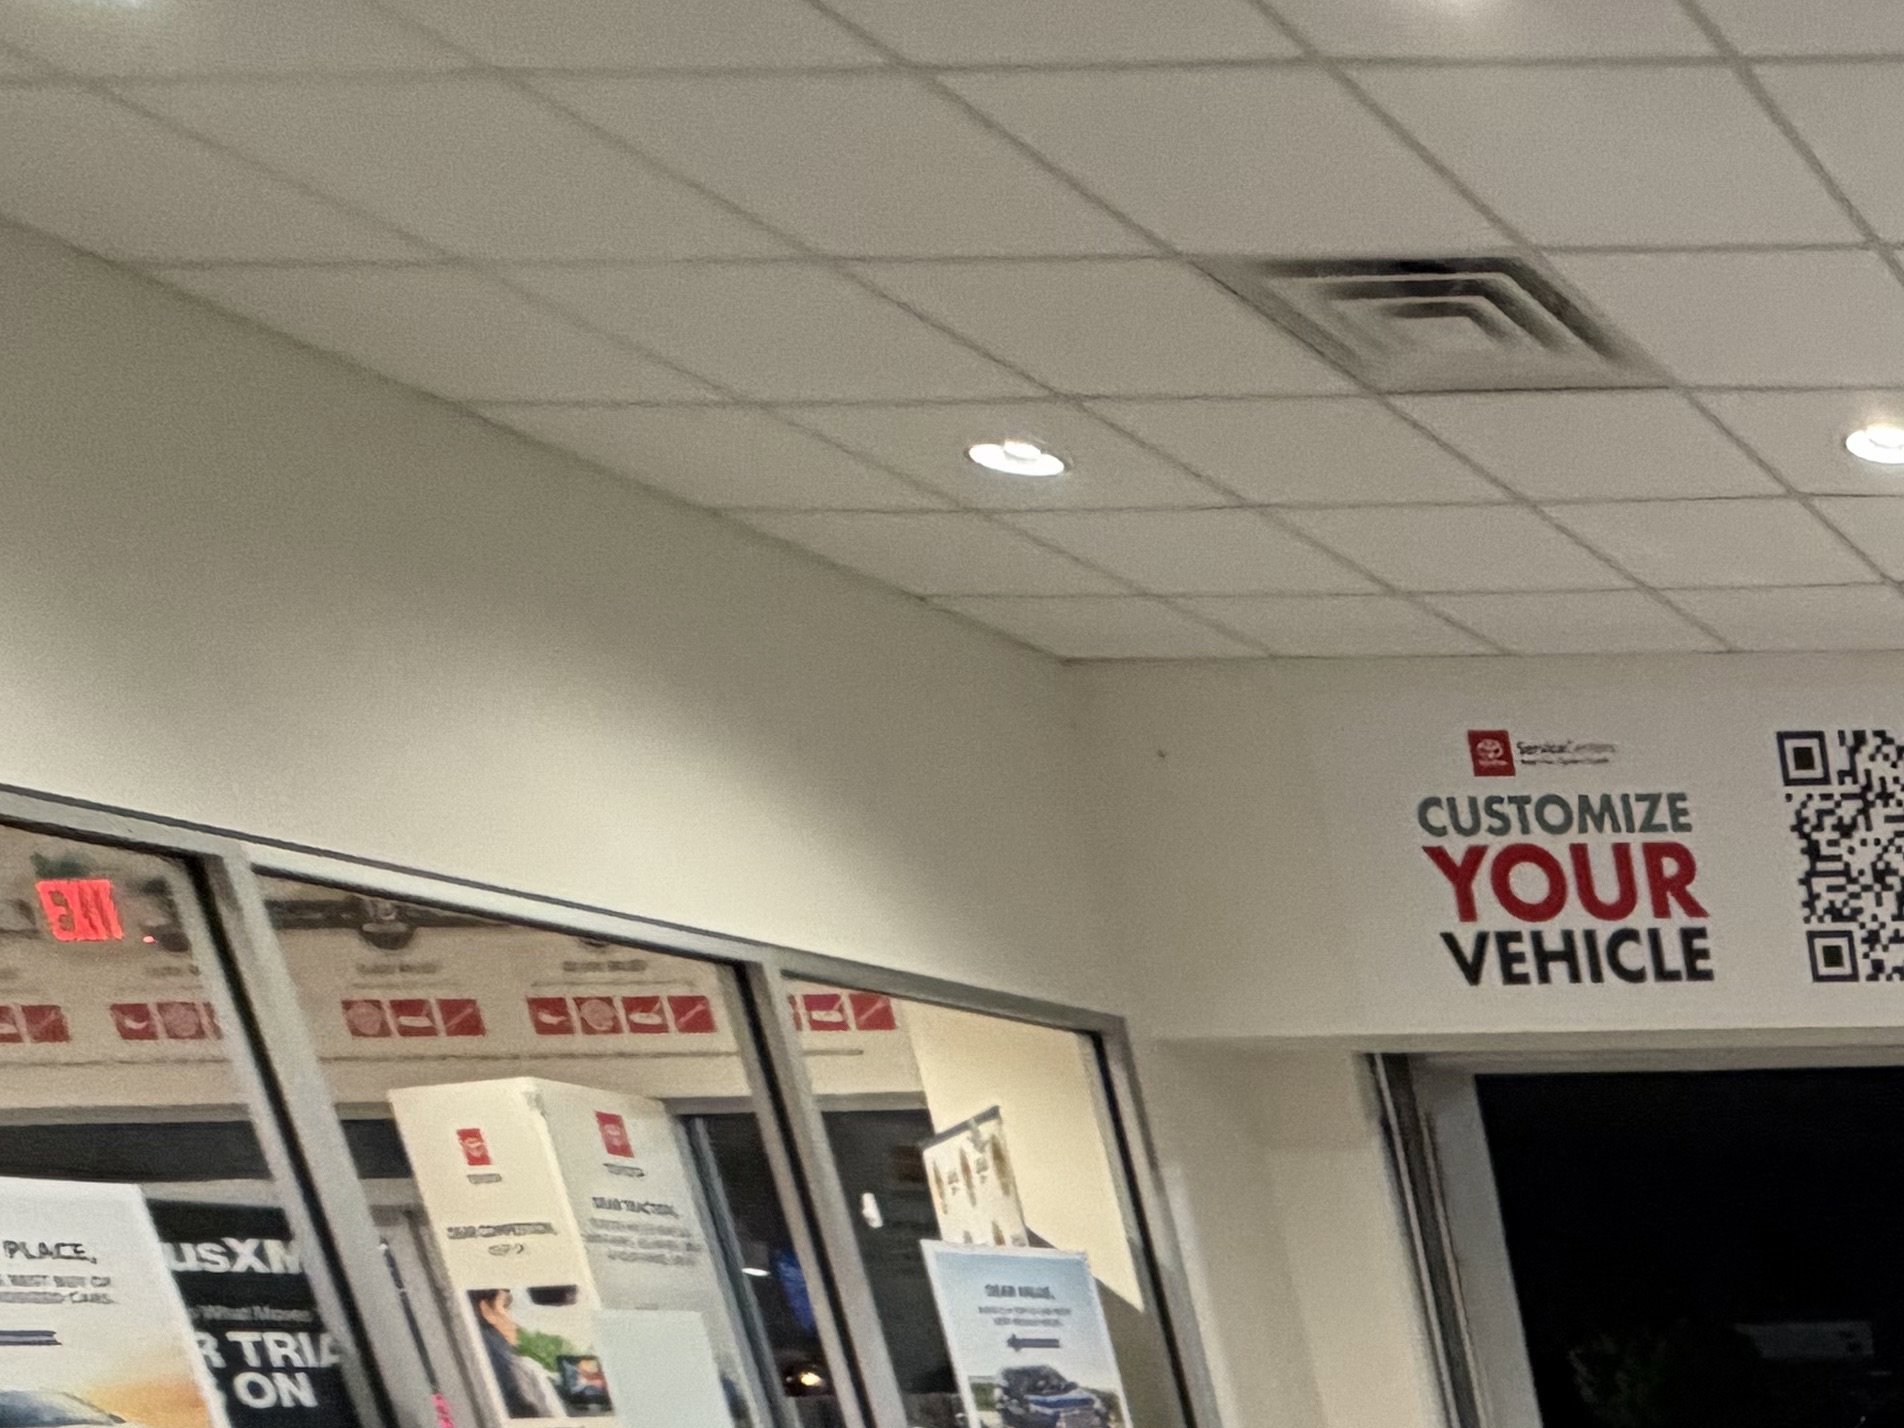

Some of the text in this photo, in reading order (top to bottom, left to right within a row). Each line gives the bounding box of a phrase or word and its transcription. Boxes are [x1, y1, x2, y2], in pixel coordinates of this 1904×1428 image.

[1417, 792, 1694, 838] CUSTOMIZE
[1422, 841, 1711, 922] YOUR
[1439, 926, 1715, 985] VEHICLE
[232, 1371, 320, 1410] ON
